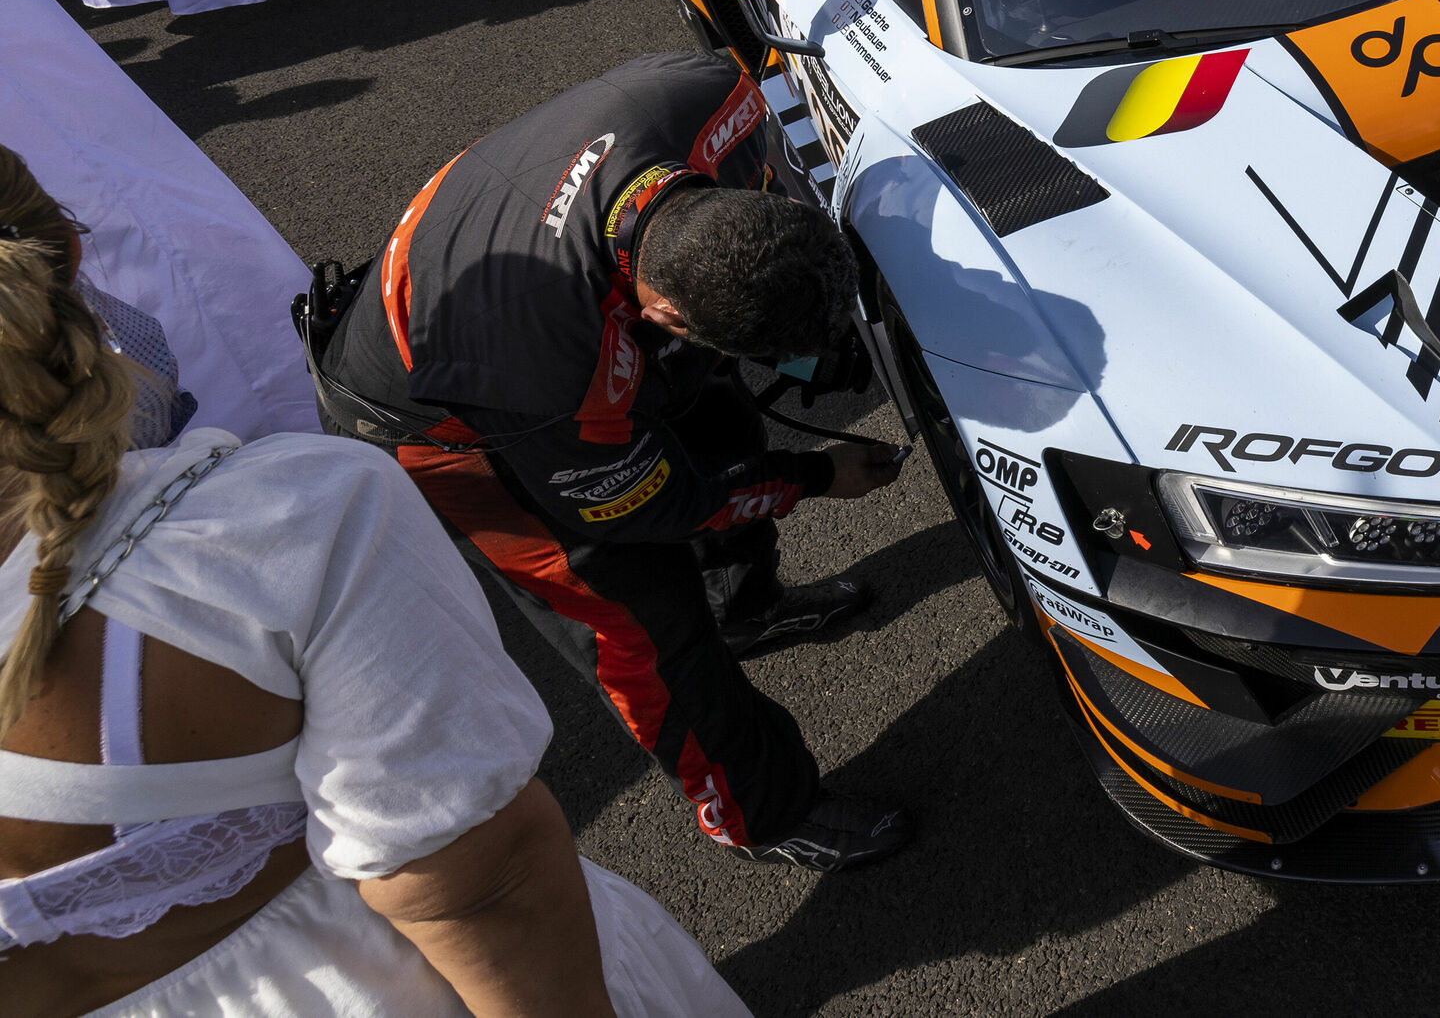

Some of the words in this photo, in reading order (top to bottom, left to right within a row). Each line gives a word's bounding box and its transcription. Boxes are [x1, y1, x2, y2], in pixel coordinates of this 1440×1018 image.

[711, 89, 758, 153] WRT
[545, 150, 600, 239] WRT
[589, 469, 665, 519] PIRELLI
[976, 447, 1038, 492] OMP
[1010, 508, 1066, 547] R8
[1003, 528, 1081, 580] Snap-on
